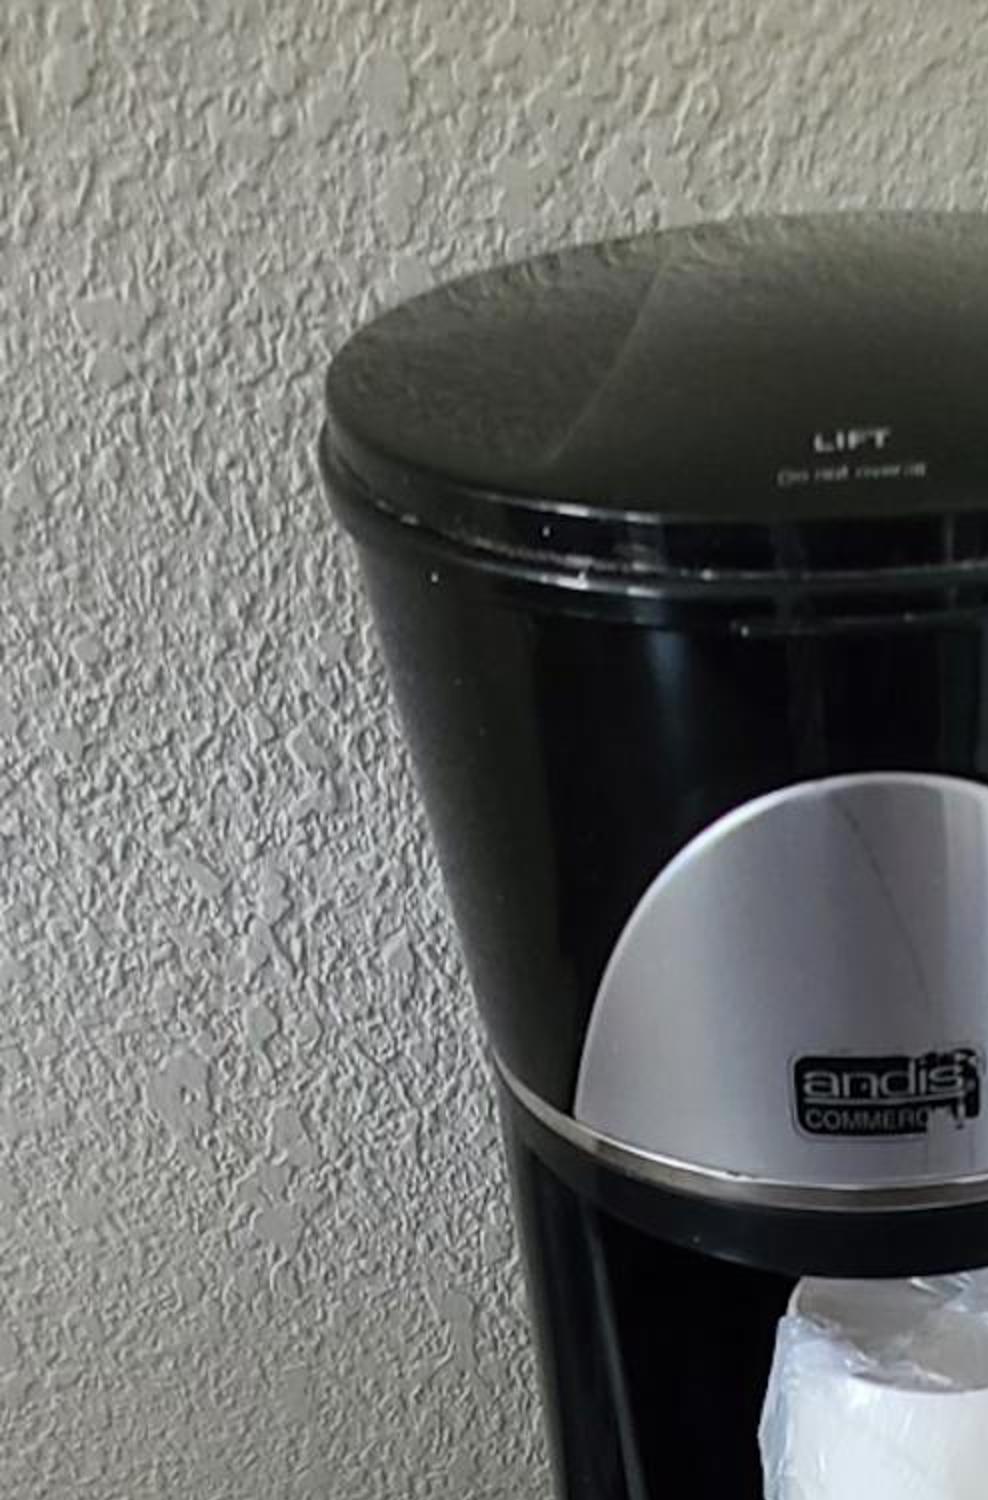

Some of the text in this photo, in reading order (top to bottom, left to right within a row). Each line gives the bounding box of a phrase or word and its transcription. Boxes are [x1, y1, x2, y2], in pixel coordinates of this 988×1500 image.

[813, 427, 891, 452] LIFT
[803, 1058, 964, 1098] andis
[805, 1105, 932, 1130] COMMERC
